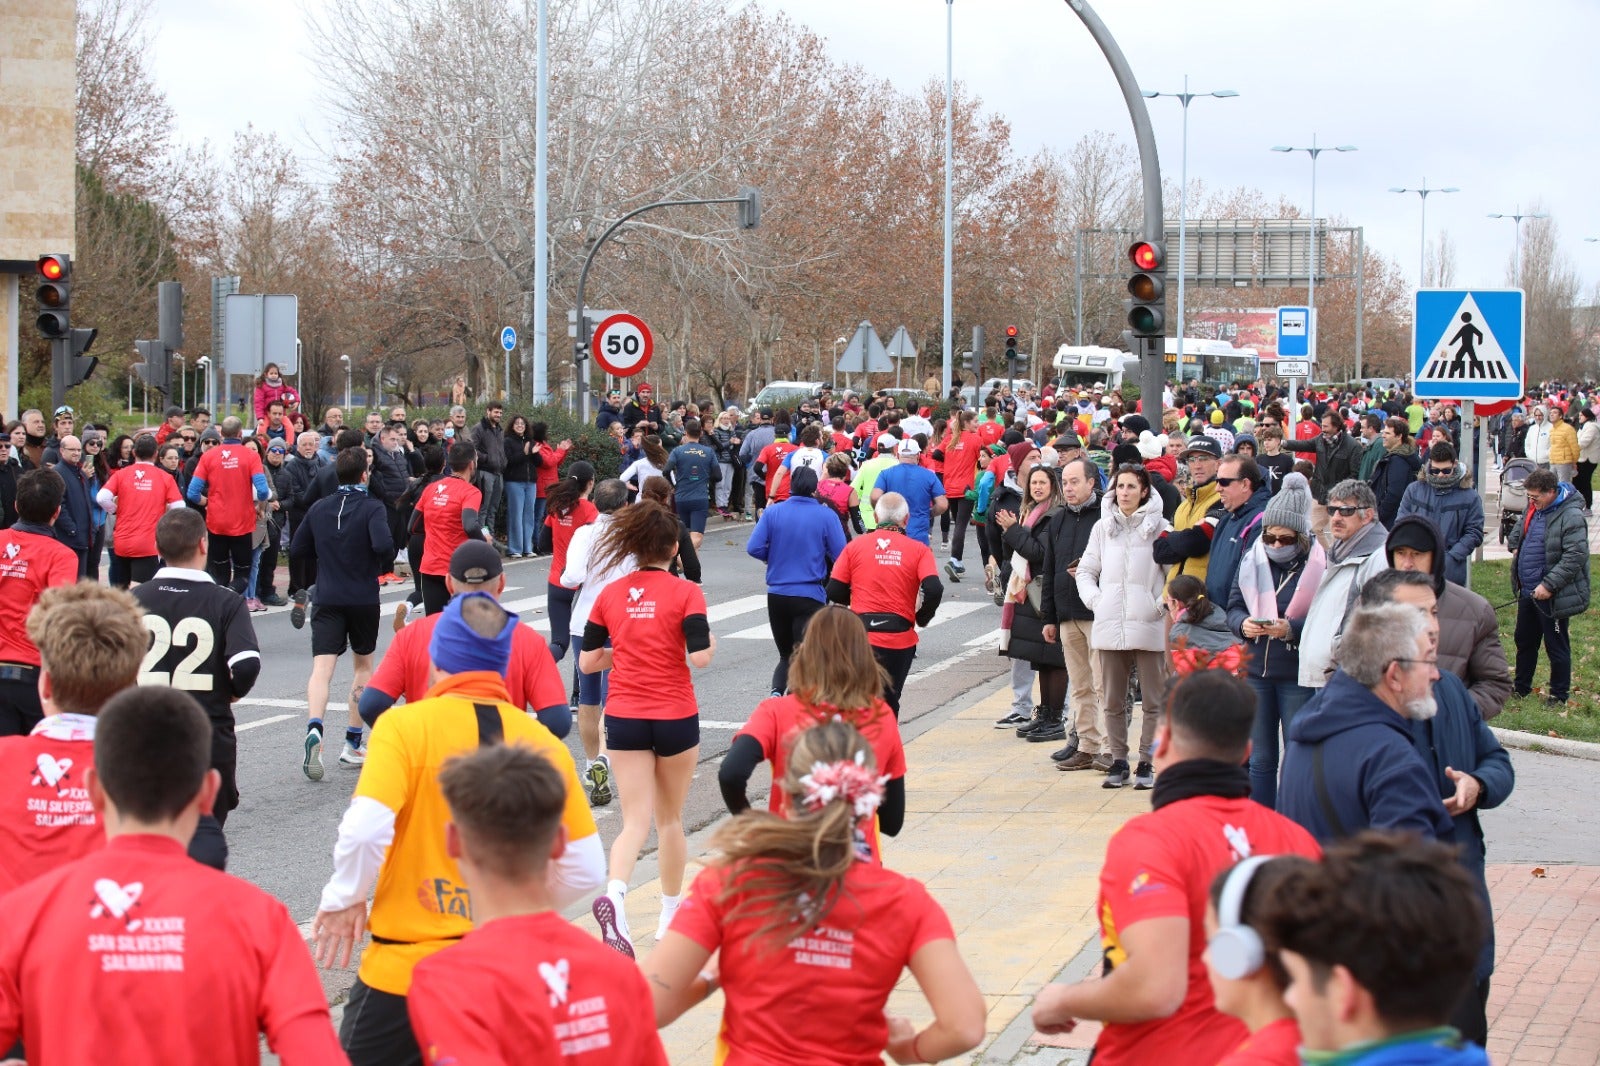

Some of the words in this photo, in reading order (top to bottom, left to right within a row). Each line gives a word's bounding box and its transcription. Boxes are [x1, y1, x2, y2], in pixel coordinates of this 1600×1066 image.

[606, 335, 640, 355] 50
[136, 614, 215, 691] 22
[27, 798, 47, 812] SAN
[48, 801, 95, 814] SILVESTR
[35, 813, 97, 826] SALMANTINA
[143, 918, 186, 931] XXXIX
[89, 934, 116, 952] SAN
[117, 934, 185, 952] SILVESTRE
[101, 953, 185, 972] SALMANTINA
